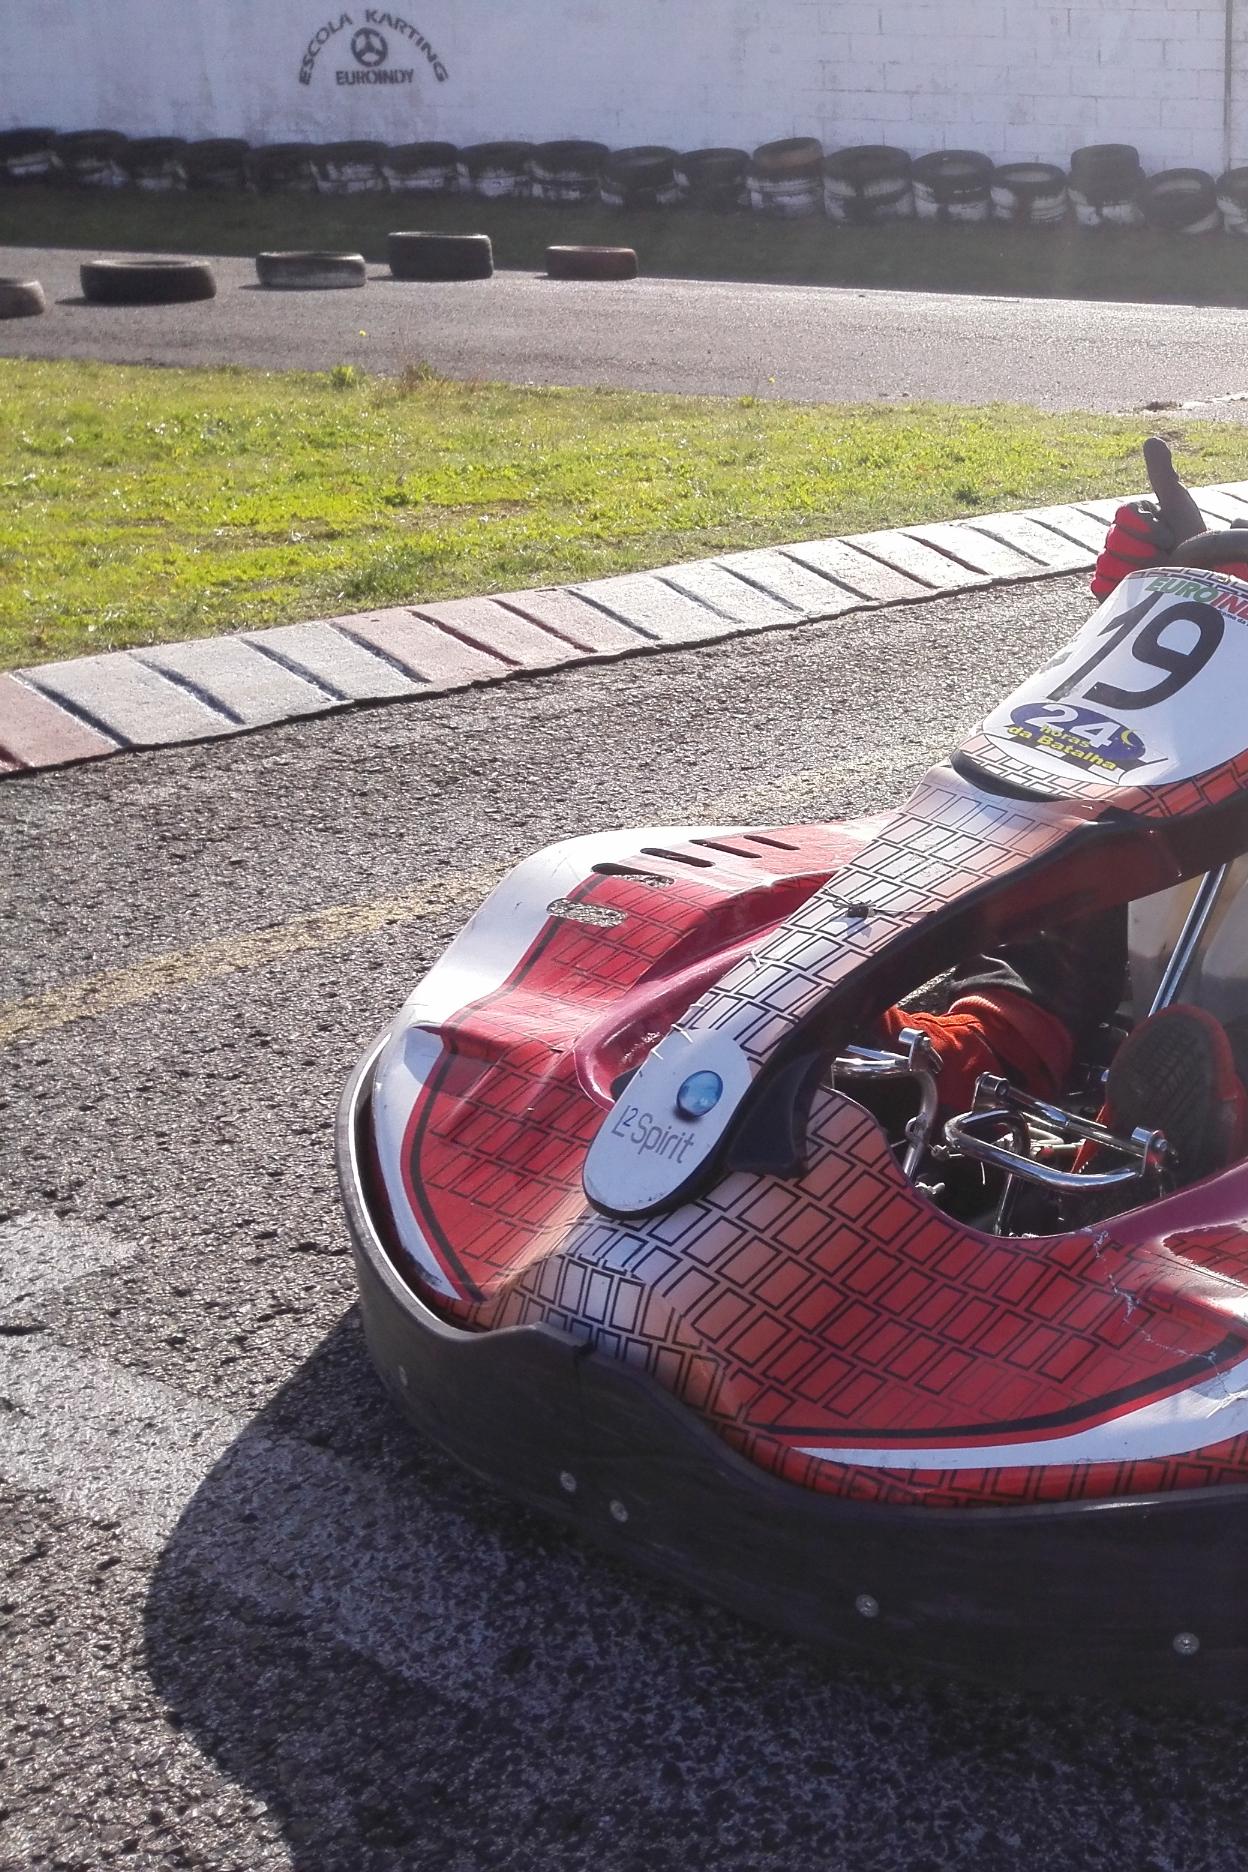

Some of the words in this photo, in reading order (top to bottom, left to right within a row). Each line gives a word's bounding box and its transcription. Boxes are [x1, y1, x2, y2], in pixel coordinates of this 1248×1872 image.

[299, 13, 353, 85] ESCOLA
[365, 9, 449, 82] KARTING
[336, 69, 414, 85] EUROINDY
[1046, 591, 1225, 710] 19
[1024, 703, 1120, 748] 24
[1040, 724, 1090, 748] horas
[1007, 726, 1033, 739] da
[1036, 735, 1118, 771] Batalha
